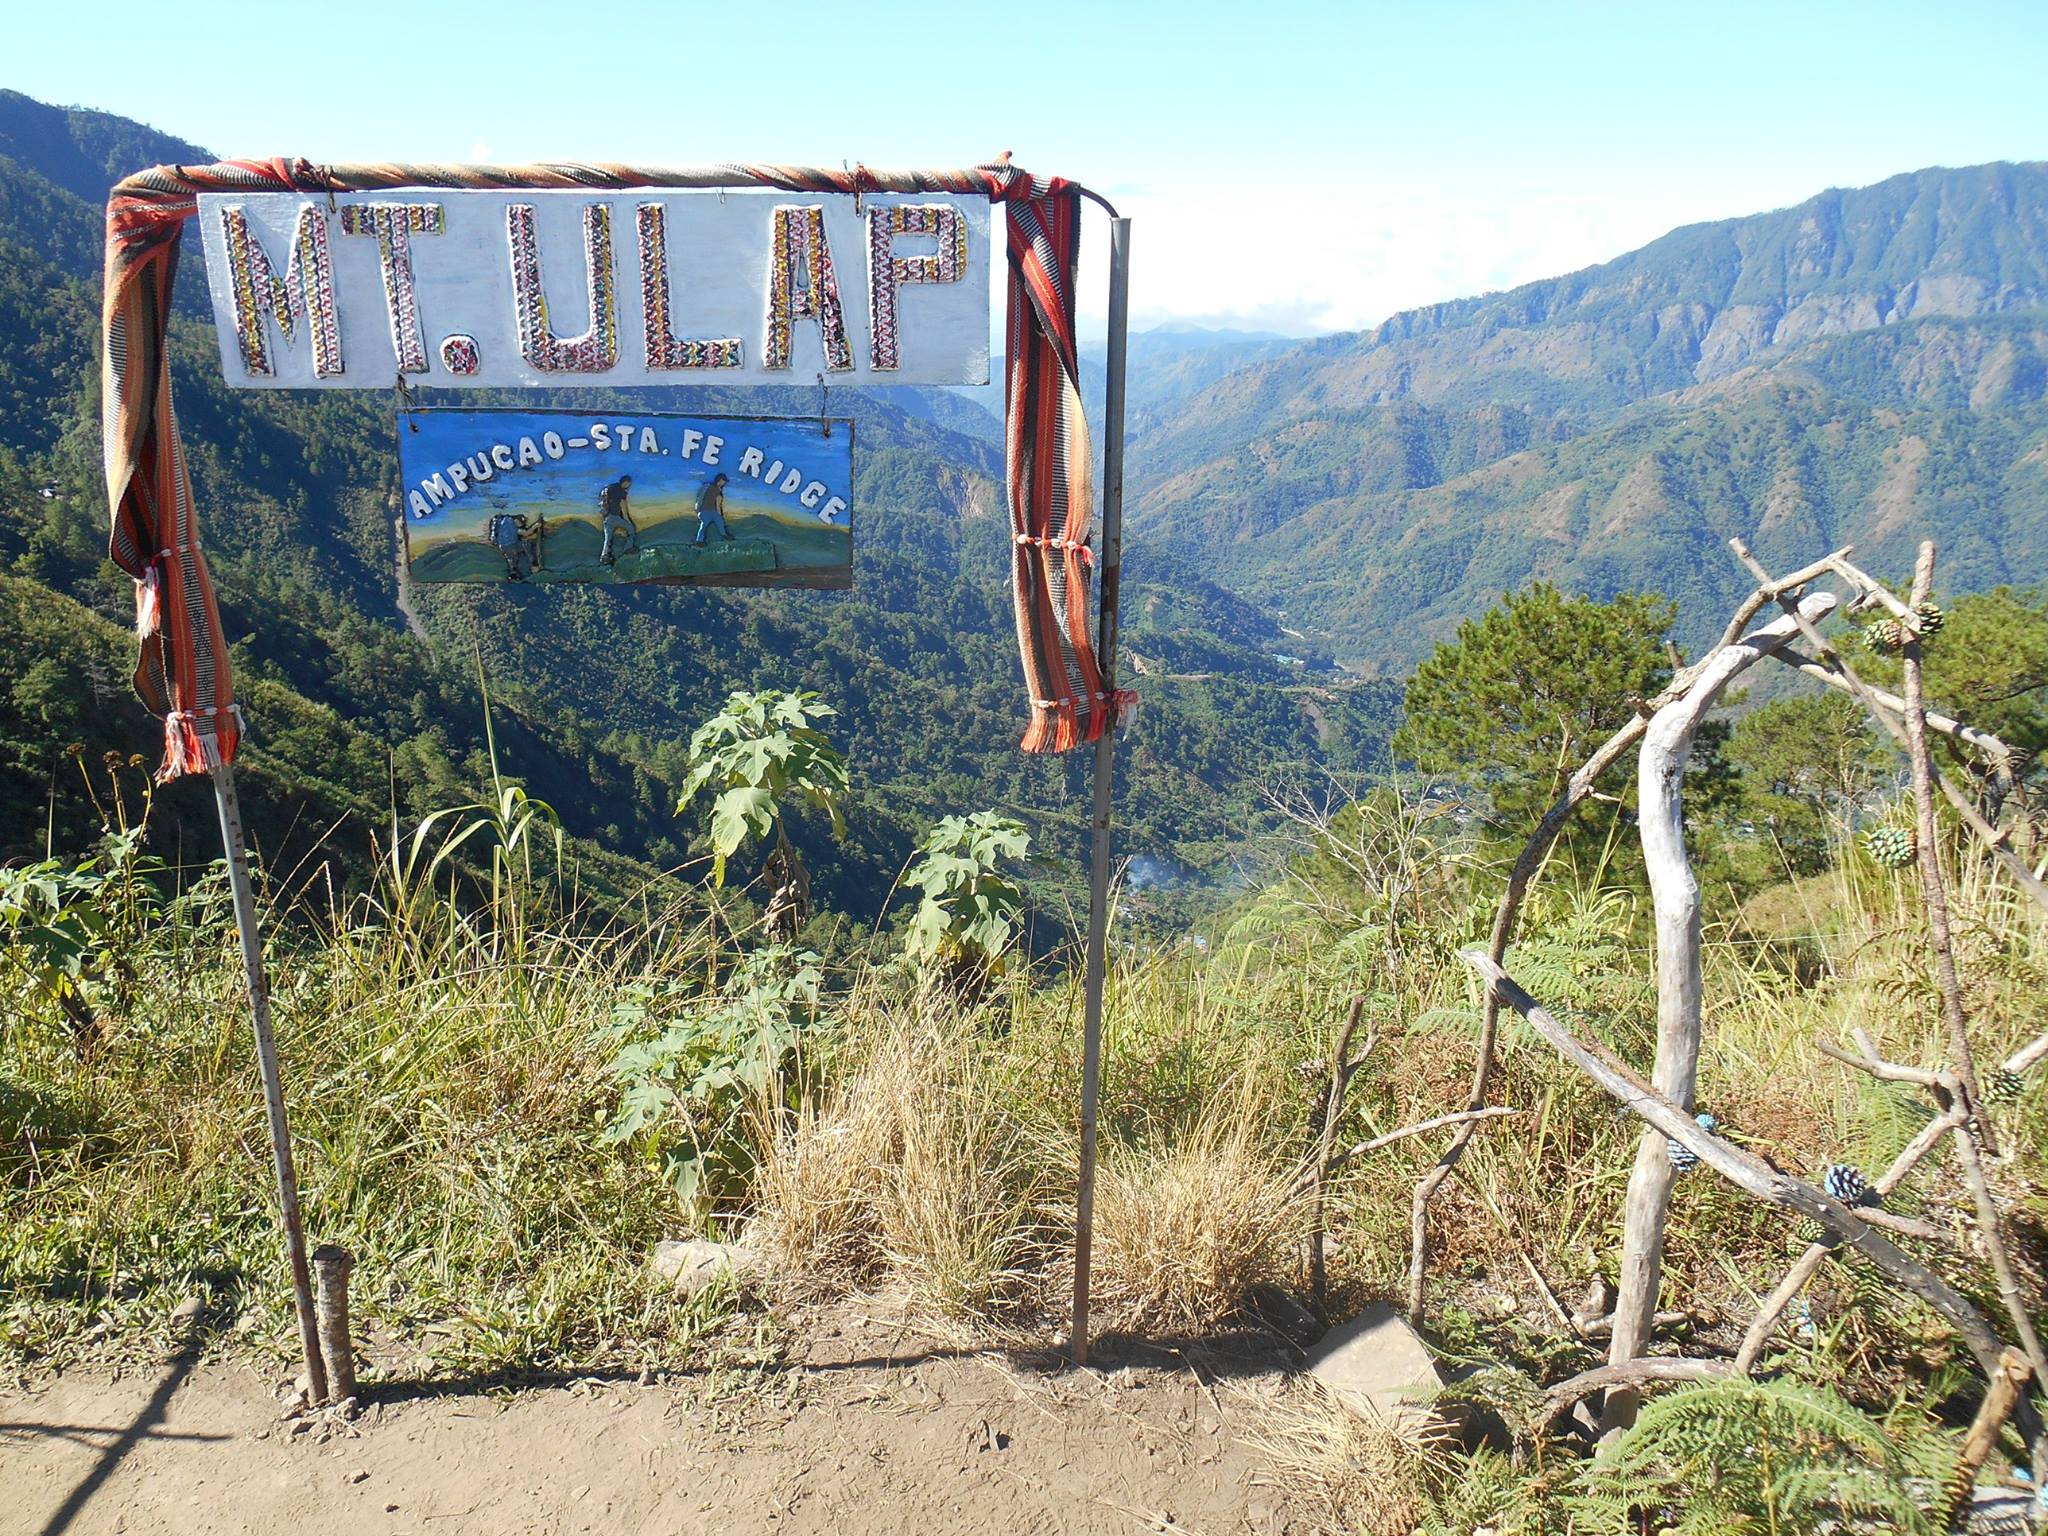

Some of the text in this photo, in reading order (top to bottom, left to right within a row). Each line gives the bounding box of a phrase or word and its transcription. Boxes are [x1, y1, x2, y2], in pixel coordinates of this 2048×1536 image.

[408, 423, 848, 525] AMPUCAO-STA. FE RIDGE
